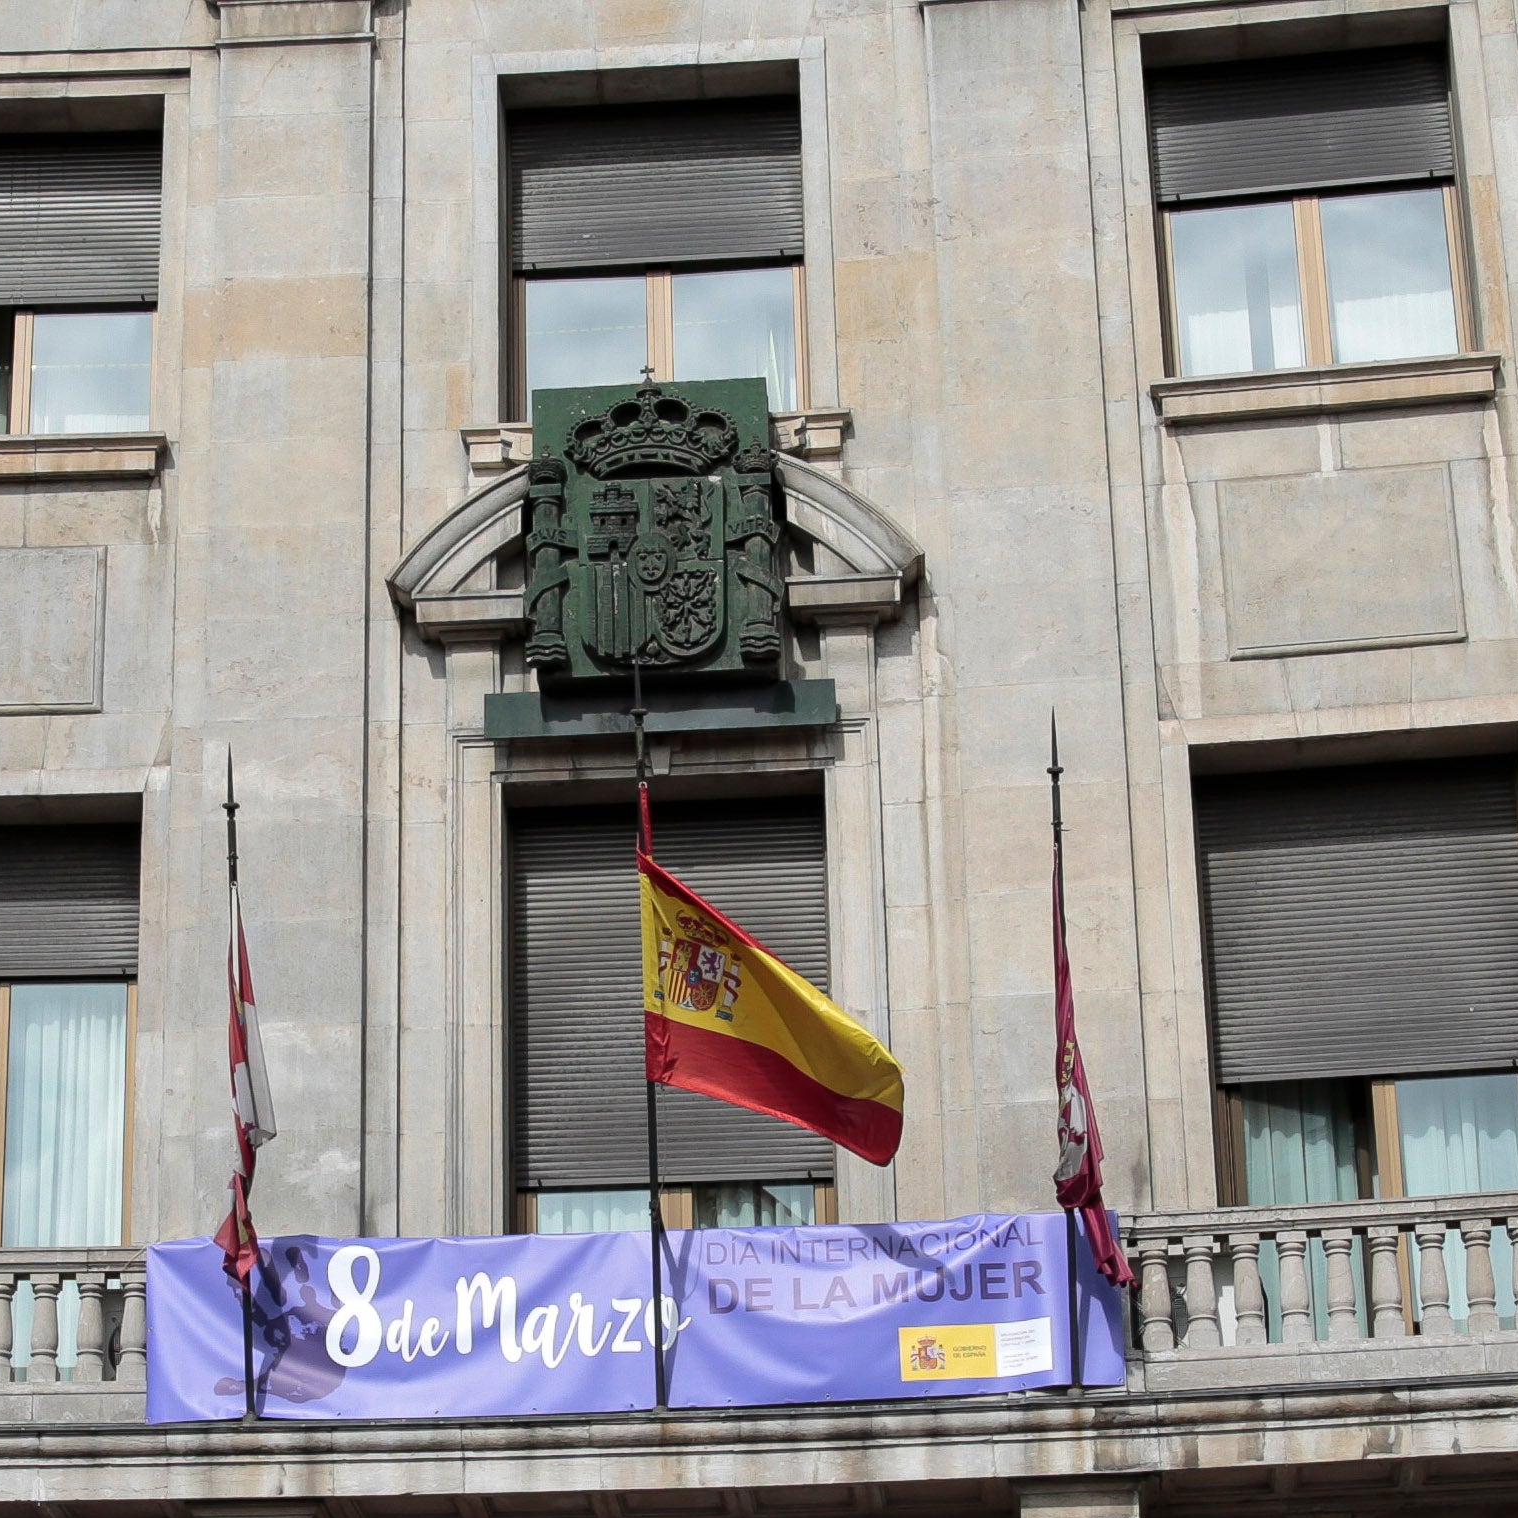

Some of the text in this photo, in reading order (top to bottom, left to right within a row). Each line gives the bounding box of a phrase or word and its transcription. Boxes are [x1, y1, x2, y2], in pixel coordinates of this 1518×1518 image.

[706, 1221, 1044, 1266] DÍA INTERNACIONAL
[325, 1245, 692, 1369] 8 de Marzo
[707, 1259, 1048, 1315] DE LA MUJER
